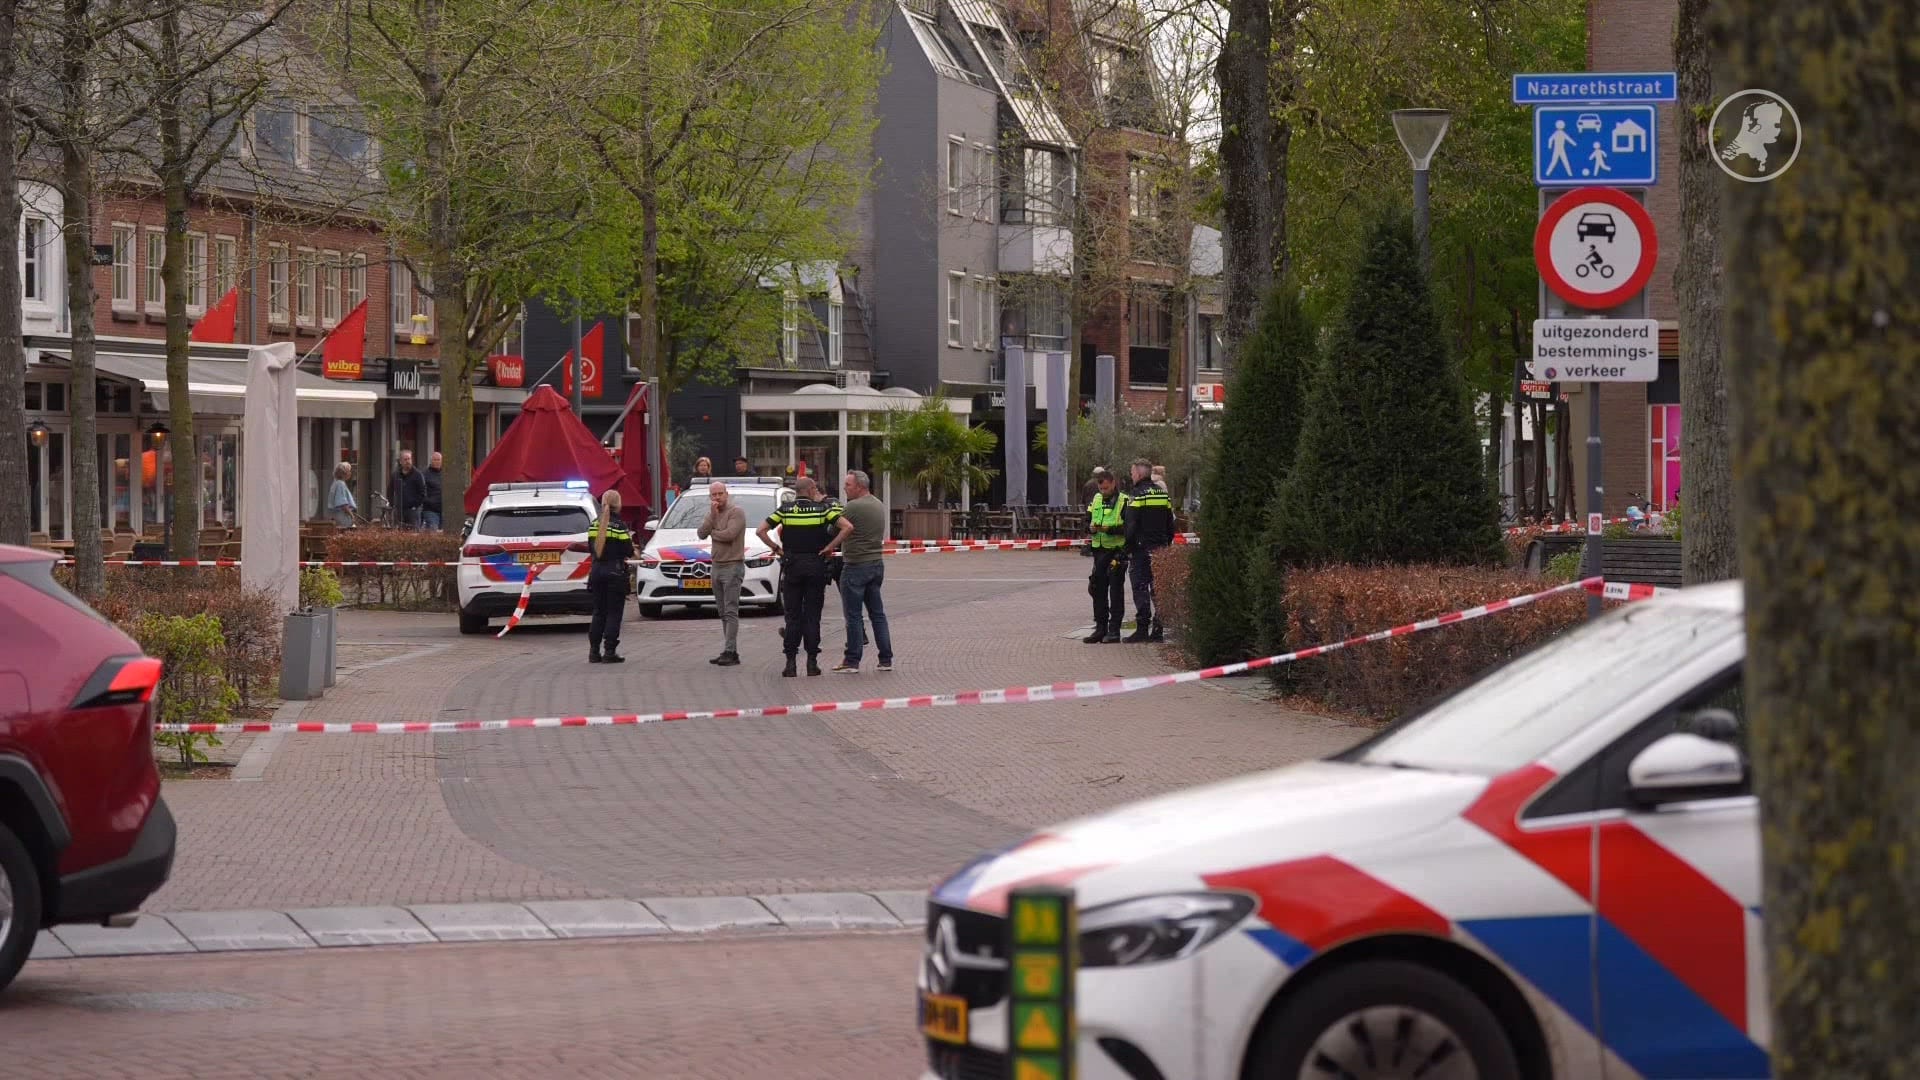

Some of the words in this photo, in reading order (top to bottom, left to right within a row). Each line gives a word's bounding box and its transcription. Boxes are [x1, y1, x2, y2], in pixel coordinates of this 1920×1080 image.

[1527, 81, 1662, 96] Nazarethstraat
[1542, 325, 1649, 341] uitgezonderd
[1538, 345, 1654, 361] bestemmings-
[327, 360, 360, 371] wibra
[1565, 364, 1626, 377] verkeer
[394, 365, 420, 390] norah
[1522, 384, 1546, 392] OUTLET
[519, 552, 558, 561] HXP-93N
